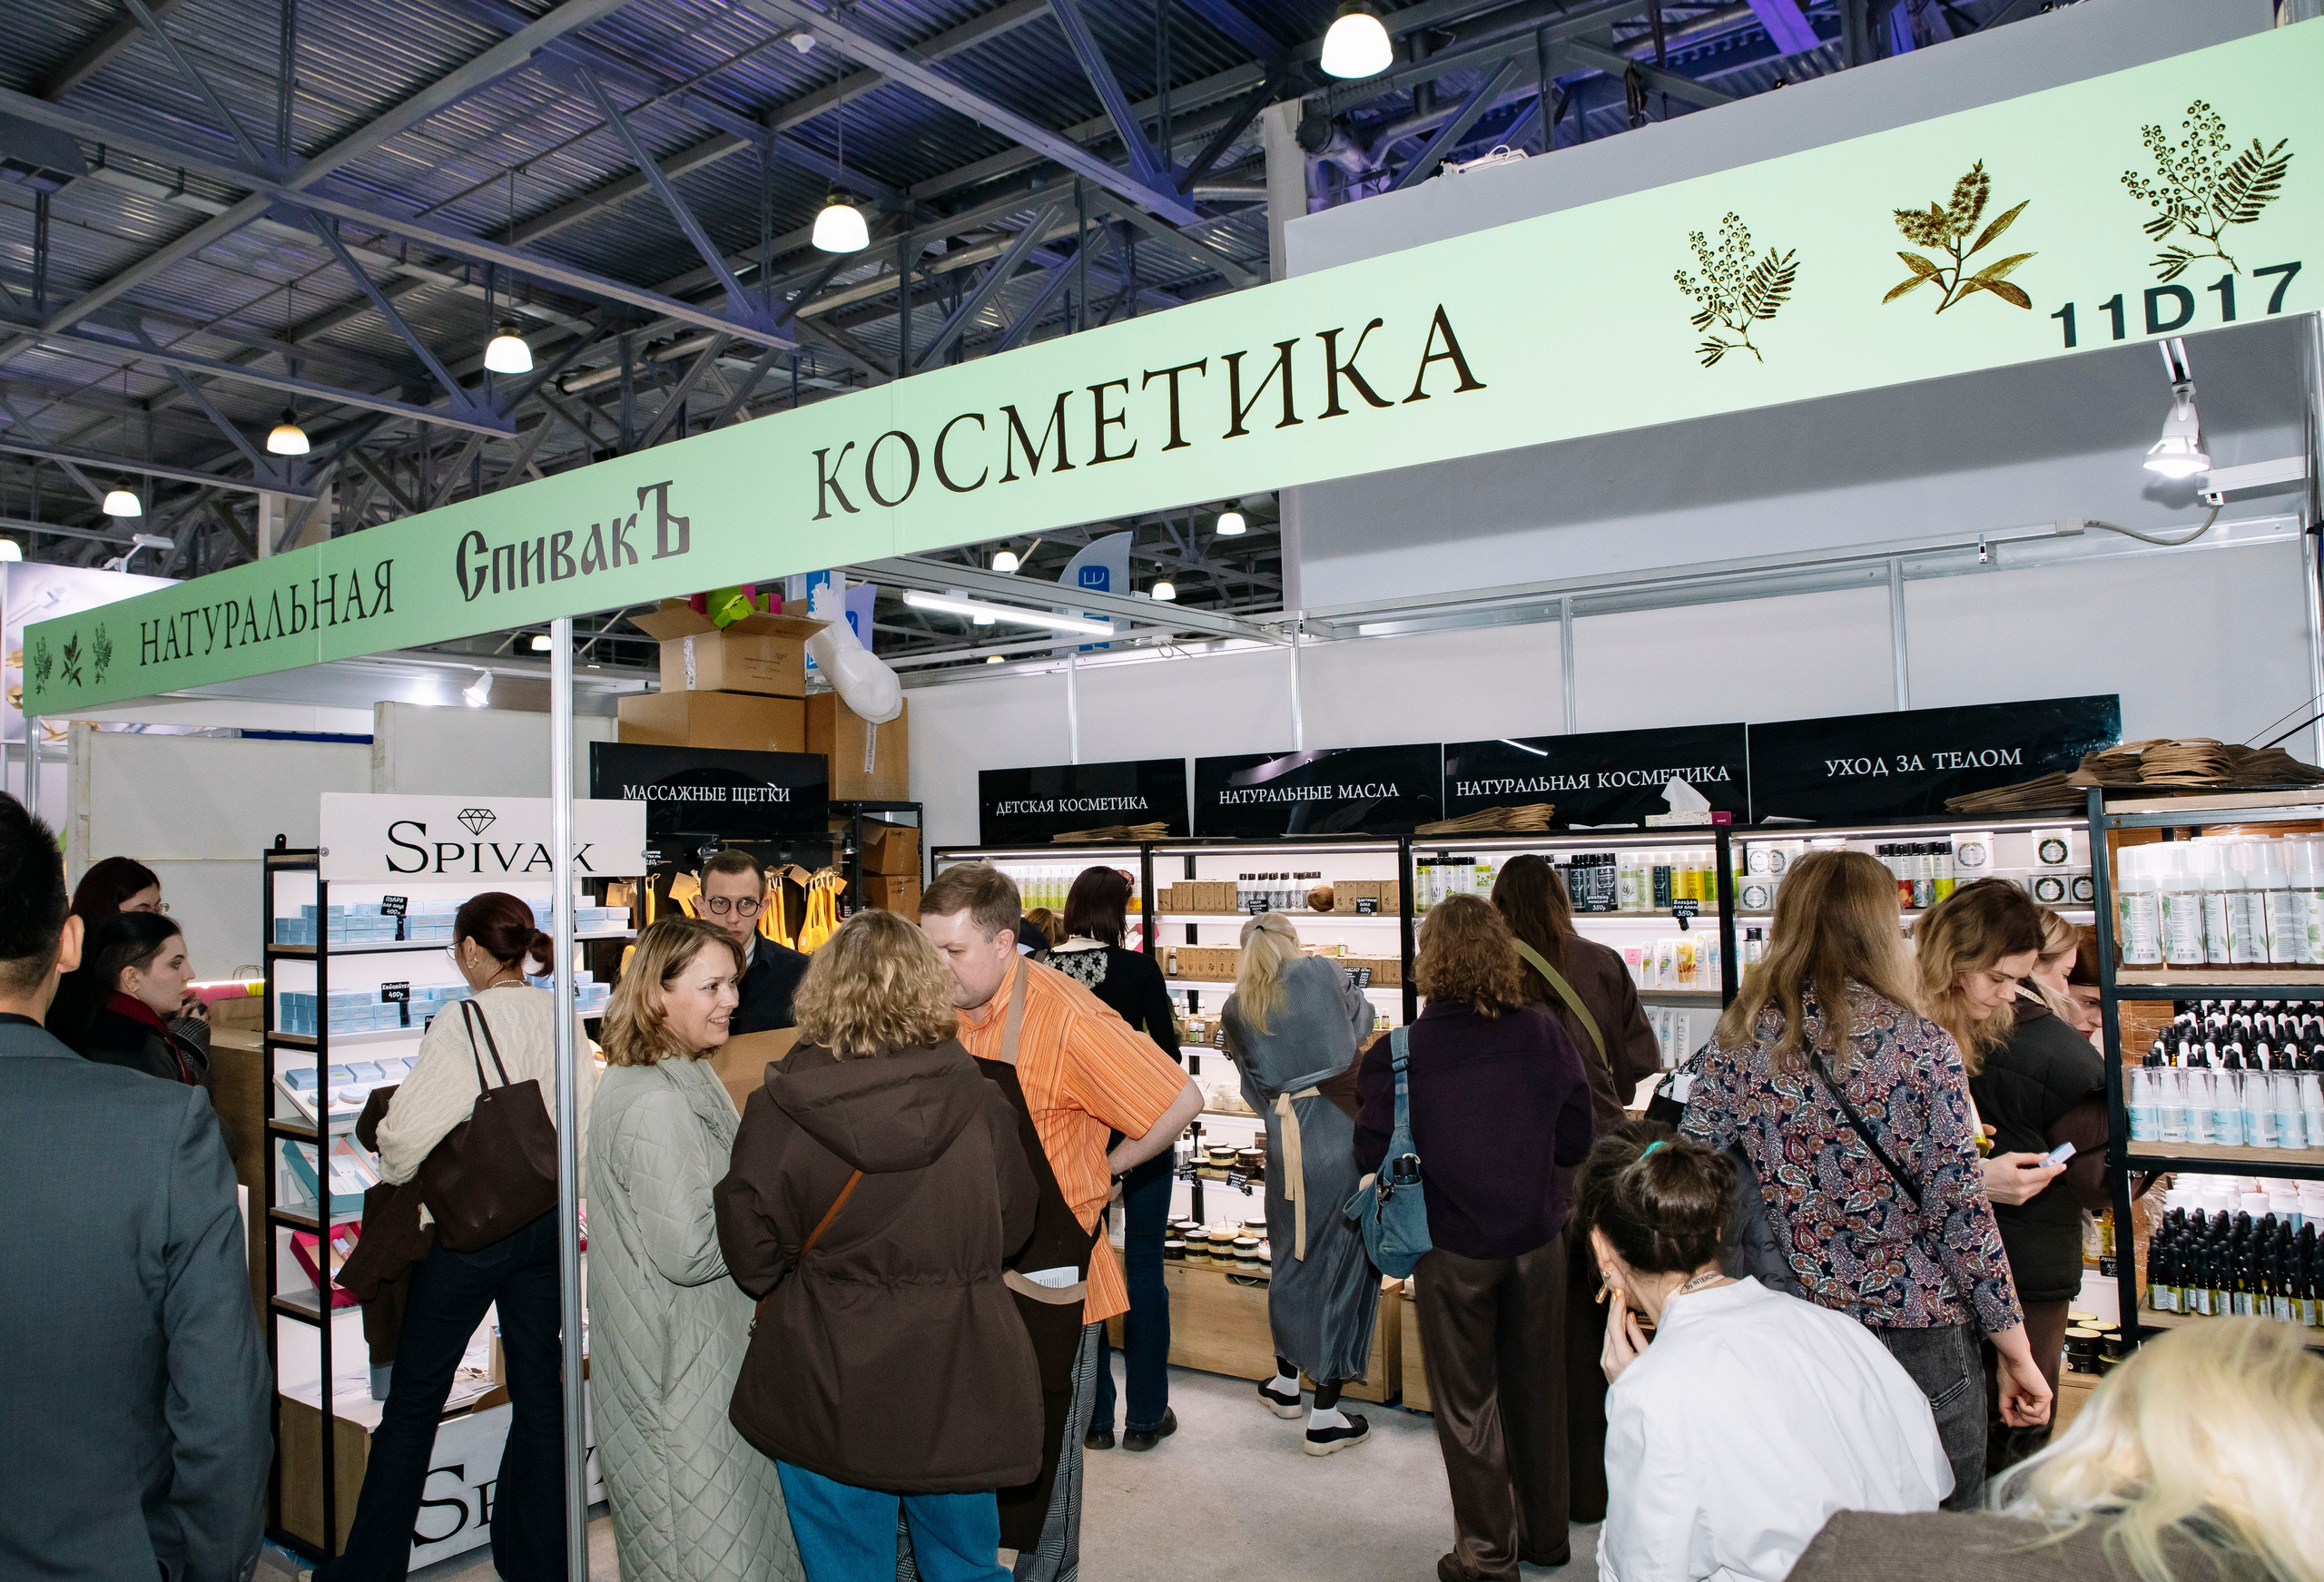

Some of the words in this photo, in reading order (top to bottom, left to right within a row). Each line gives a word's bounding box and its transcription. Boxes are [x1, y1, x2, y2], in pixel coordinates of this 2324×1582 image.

[2051, 261, 2301, 348] 11D17
[140, 559, 394, 666] НАТУРАЛЬНАЯ
[812, 303, 1487, 521] КОСМЕТИКА
[1825, 755, 1888, 777] УХОД
[1896, 753, 1925, 772] ЗА
[1933, 748, 2024, 770] ТЕЛОМ
[623, 784, 727, 802] МАССАЖНЫЕ
[732, 786, 791, 804] ЩЕТКИ
[1219, 785, 1333, 805] НАТУРАЛЬНЫЕ
[1338, 782, 1400, 800] МАСЛА
[1456, 774, 1590, 796] НАТУРАЛЬНАЯ
[1597, 765, 1731, 789] КОСМЕТИКА
[996, 800, 1055, 816] ДЕТСКАЯ
[1059, 795, 1148, 813] КОСМЕТИКА
